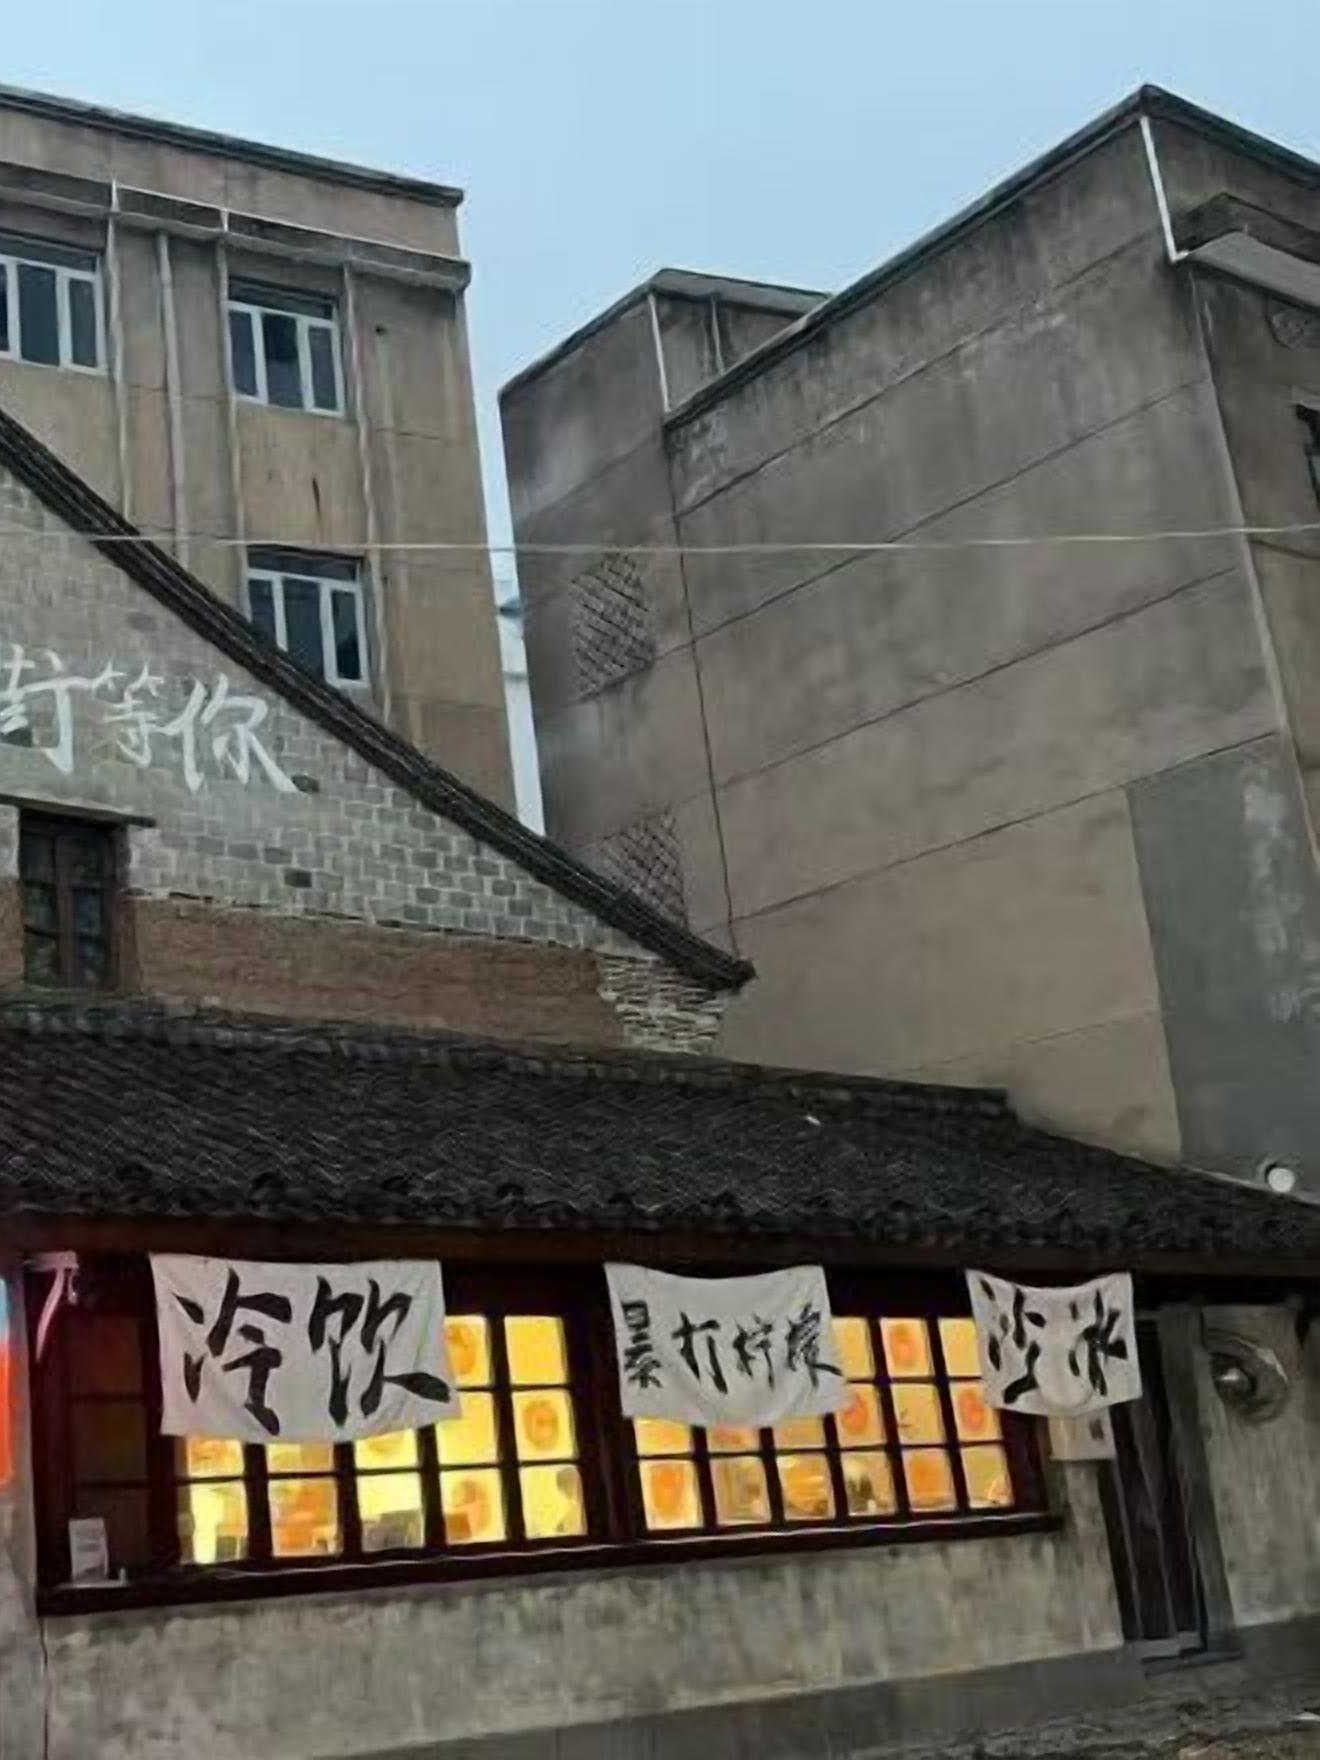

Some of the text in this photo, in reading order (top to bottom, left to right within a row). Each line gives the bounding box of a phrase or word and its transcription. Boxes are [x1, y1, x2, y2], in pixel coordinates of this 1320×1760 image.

[171, 1267, 451, 1436] 冷饮
[622, 1301, 842, 1393] 暴打柠檬
[980, 1279, 1128, 1403] 沙冰
